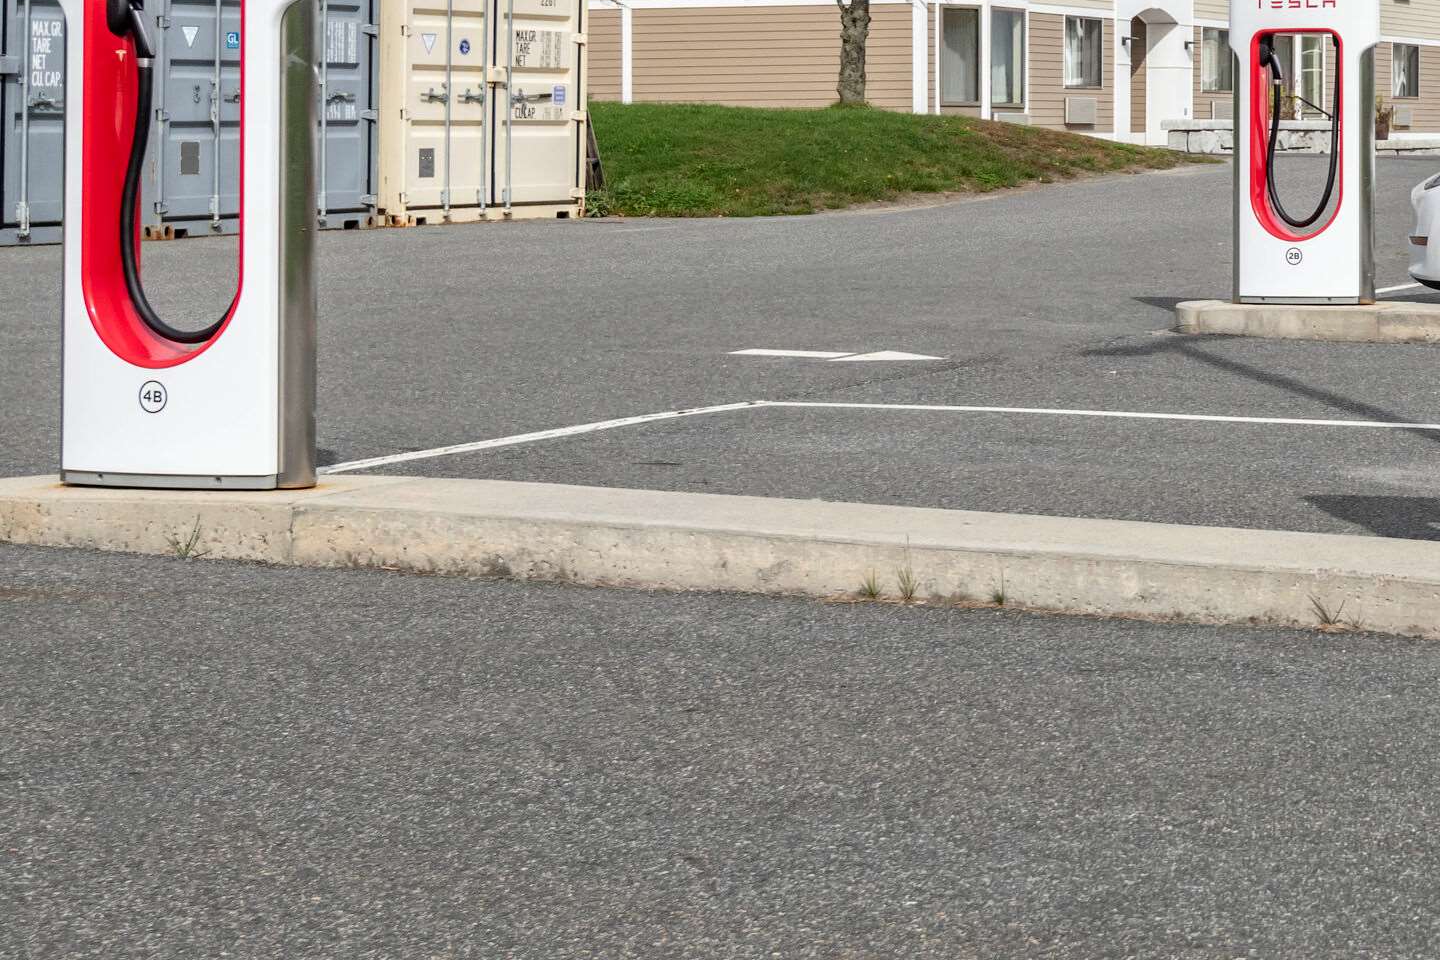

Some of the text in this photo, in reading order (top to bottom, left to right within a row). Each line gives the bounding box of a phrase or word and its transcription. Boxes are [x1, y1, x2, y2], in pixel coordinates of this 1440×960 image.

[32, 38, 52, 54] TARE
[515, 42, 531, 55] TARE
[32, 54, 47, 71] NET
[515, 55, 526, 67] NET
[1288, 252, 1300, 260] 2B
[143, 389, 162, 403] 4B
